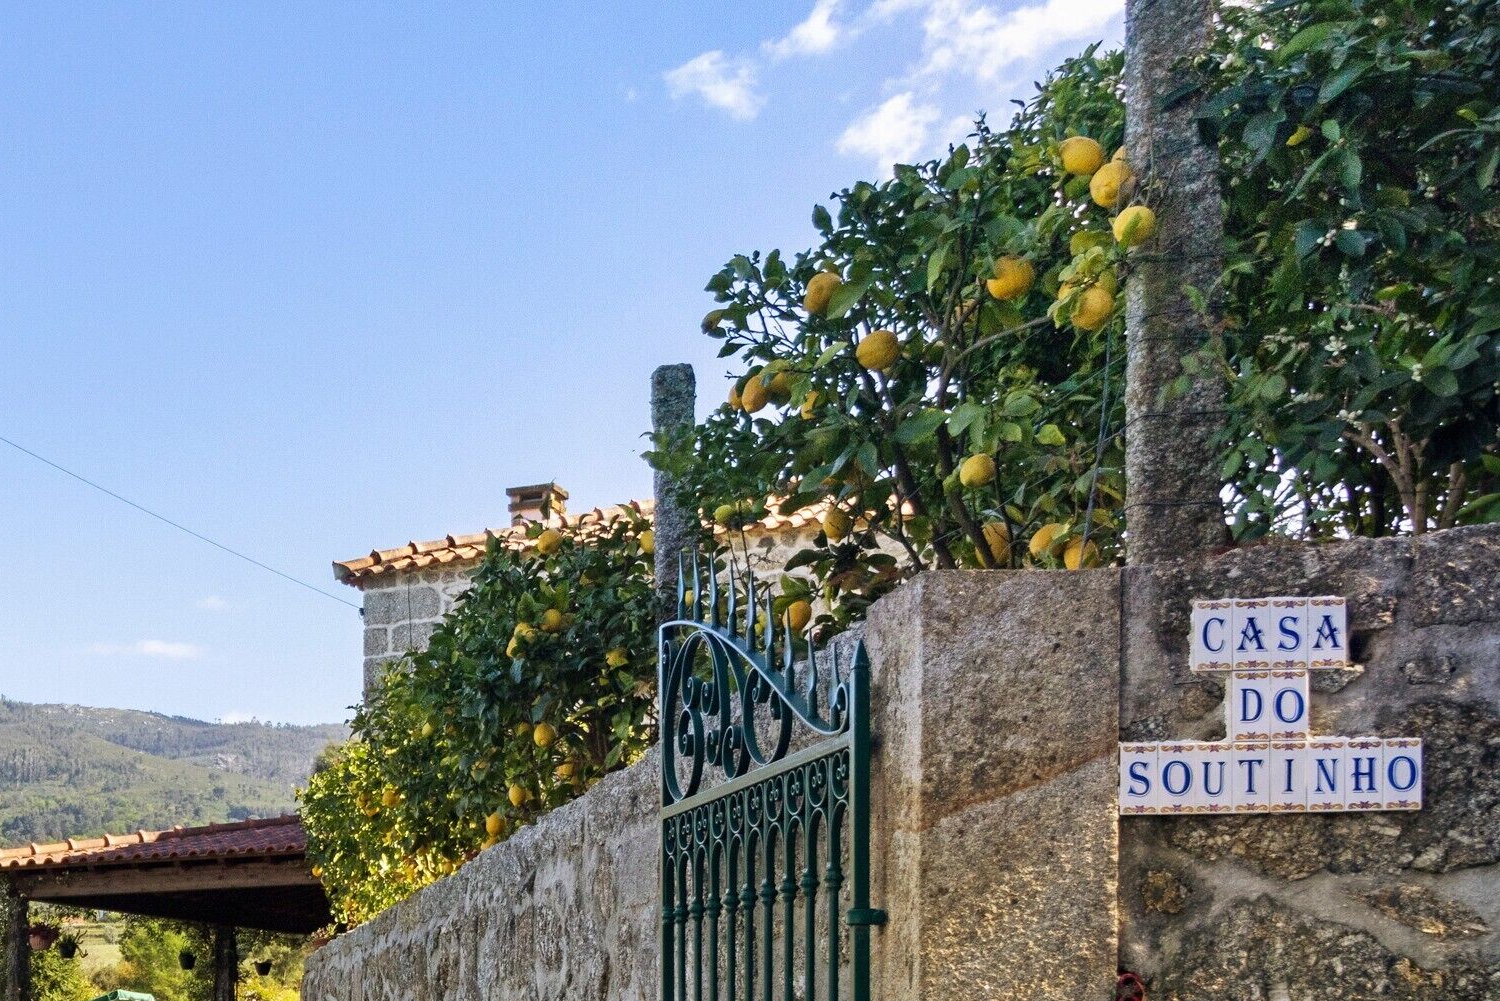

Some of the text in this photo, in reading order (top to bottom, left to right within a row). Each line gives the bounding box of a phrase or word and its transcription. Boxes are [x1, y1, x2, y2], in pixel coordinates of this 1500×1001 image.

[1202, 615, 1340, 652] CASA
[1240, 687, 1305, 723] DO
[1128, 755, 1418, 797] SOUTINHO
